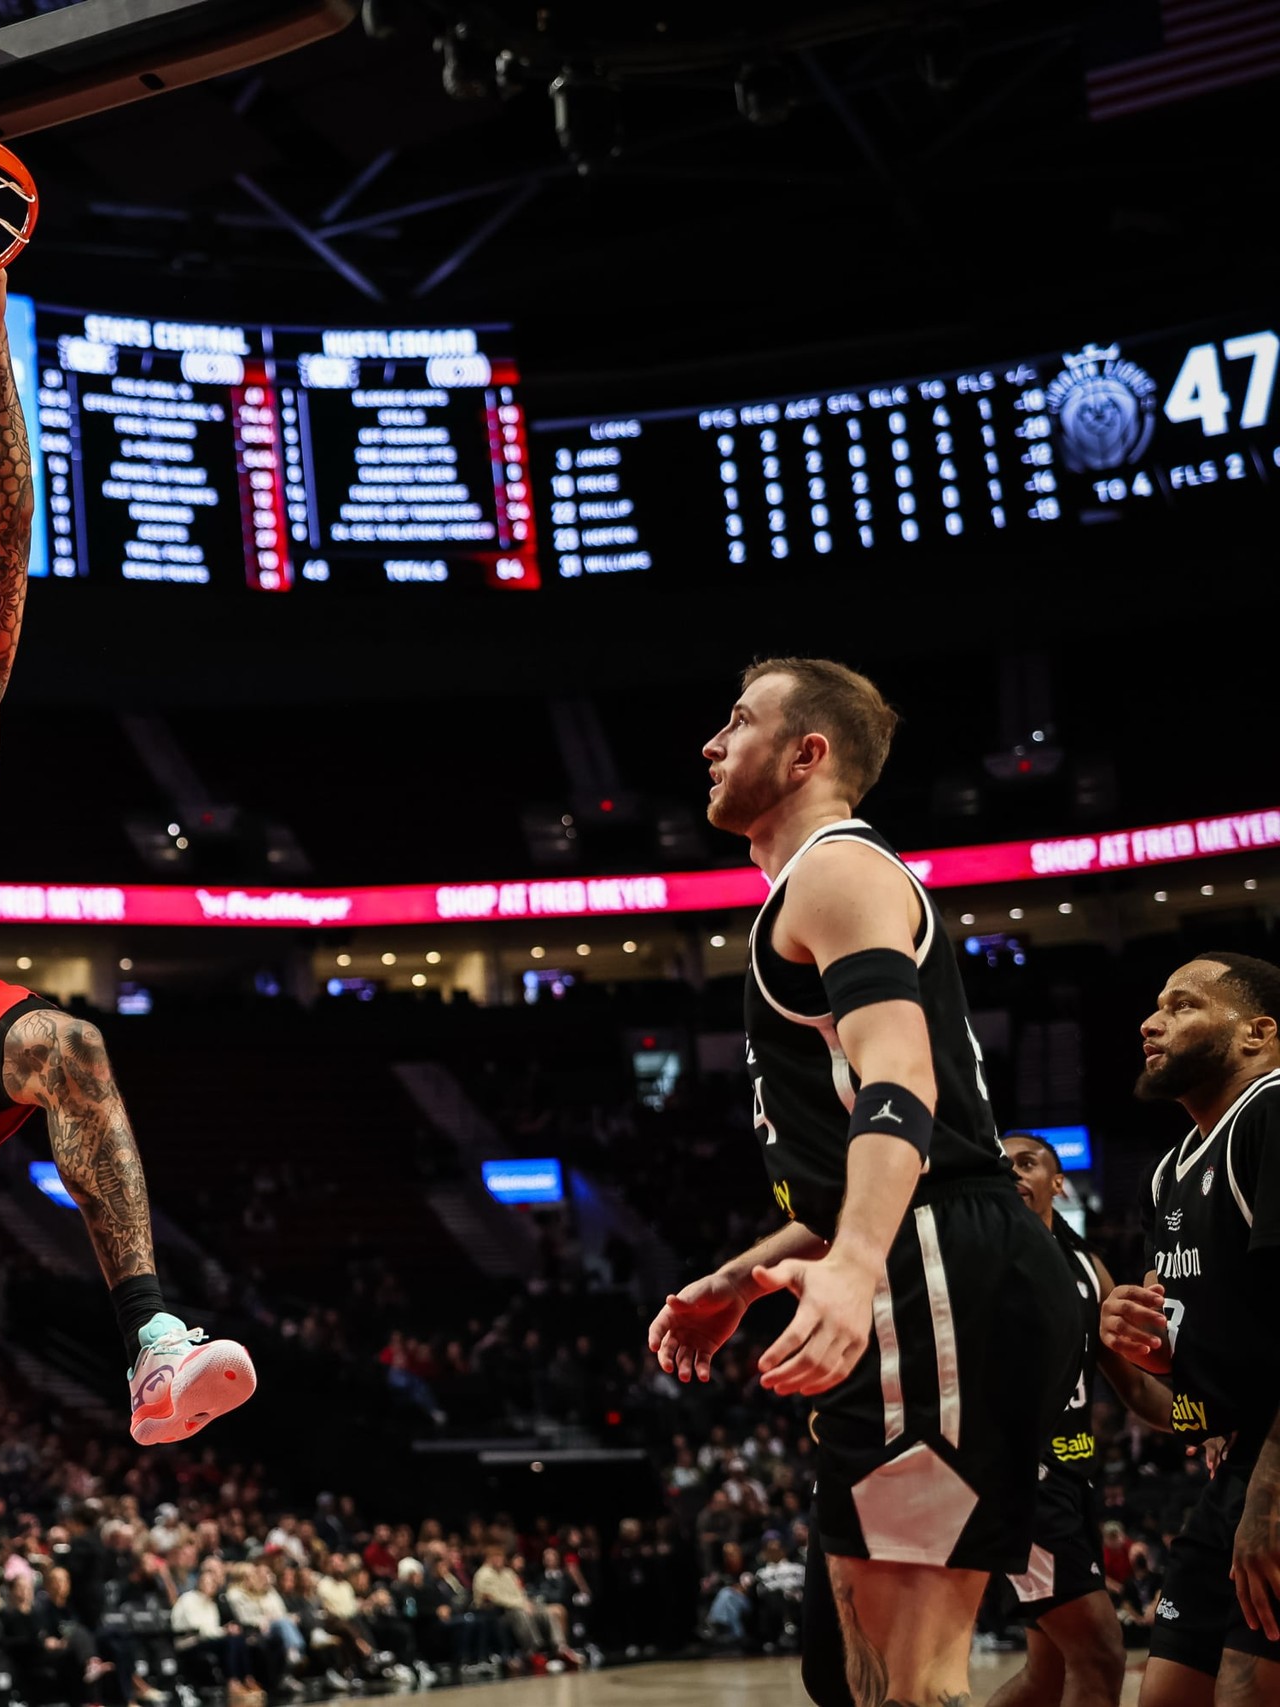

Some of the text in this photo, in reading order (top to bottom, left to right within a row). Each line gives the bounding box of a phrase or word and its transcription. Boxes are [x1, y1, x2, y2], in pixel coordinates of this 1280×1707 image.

[1163, 330, 1280, 437] 47
[1132, 471, 1153, 497] 4
[1224, 453, 1246, 480] 2
[1030, 810, 1280, 874] SHOP AT FRED MEYER
[46, 888, 125, 920] MEYER
[436, 876, 667, 919] SHOP AT FRED MEYER
[1155, 1241, 1201, 1279] ondon
[1172, 1393, 1208, 1431] aily
[1052, 1432, 1095, 1456] Saily
